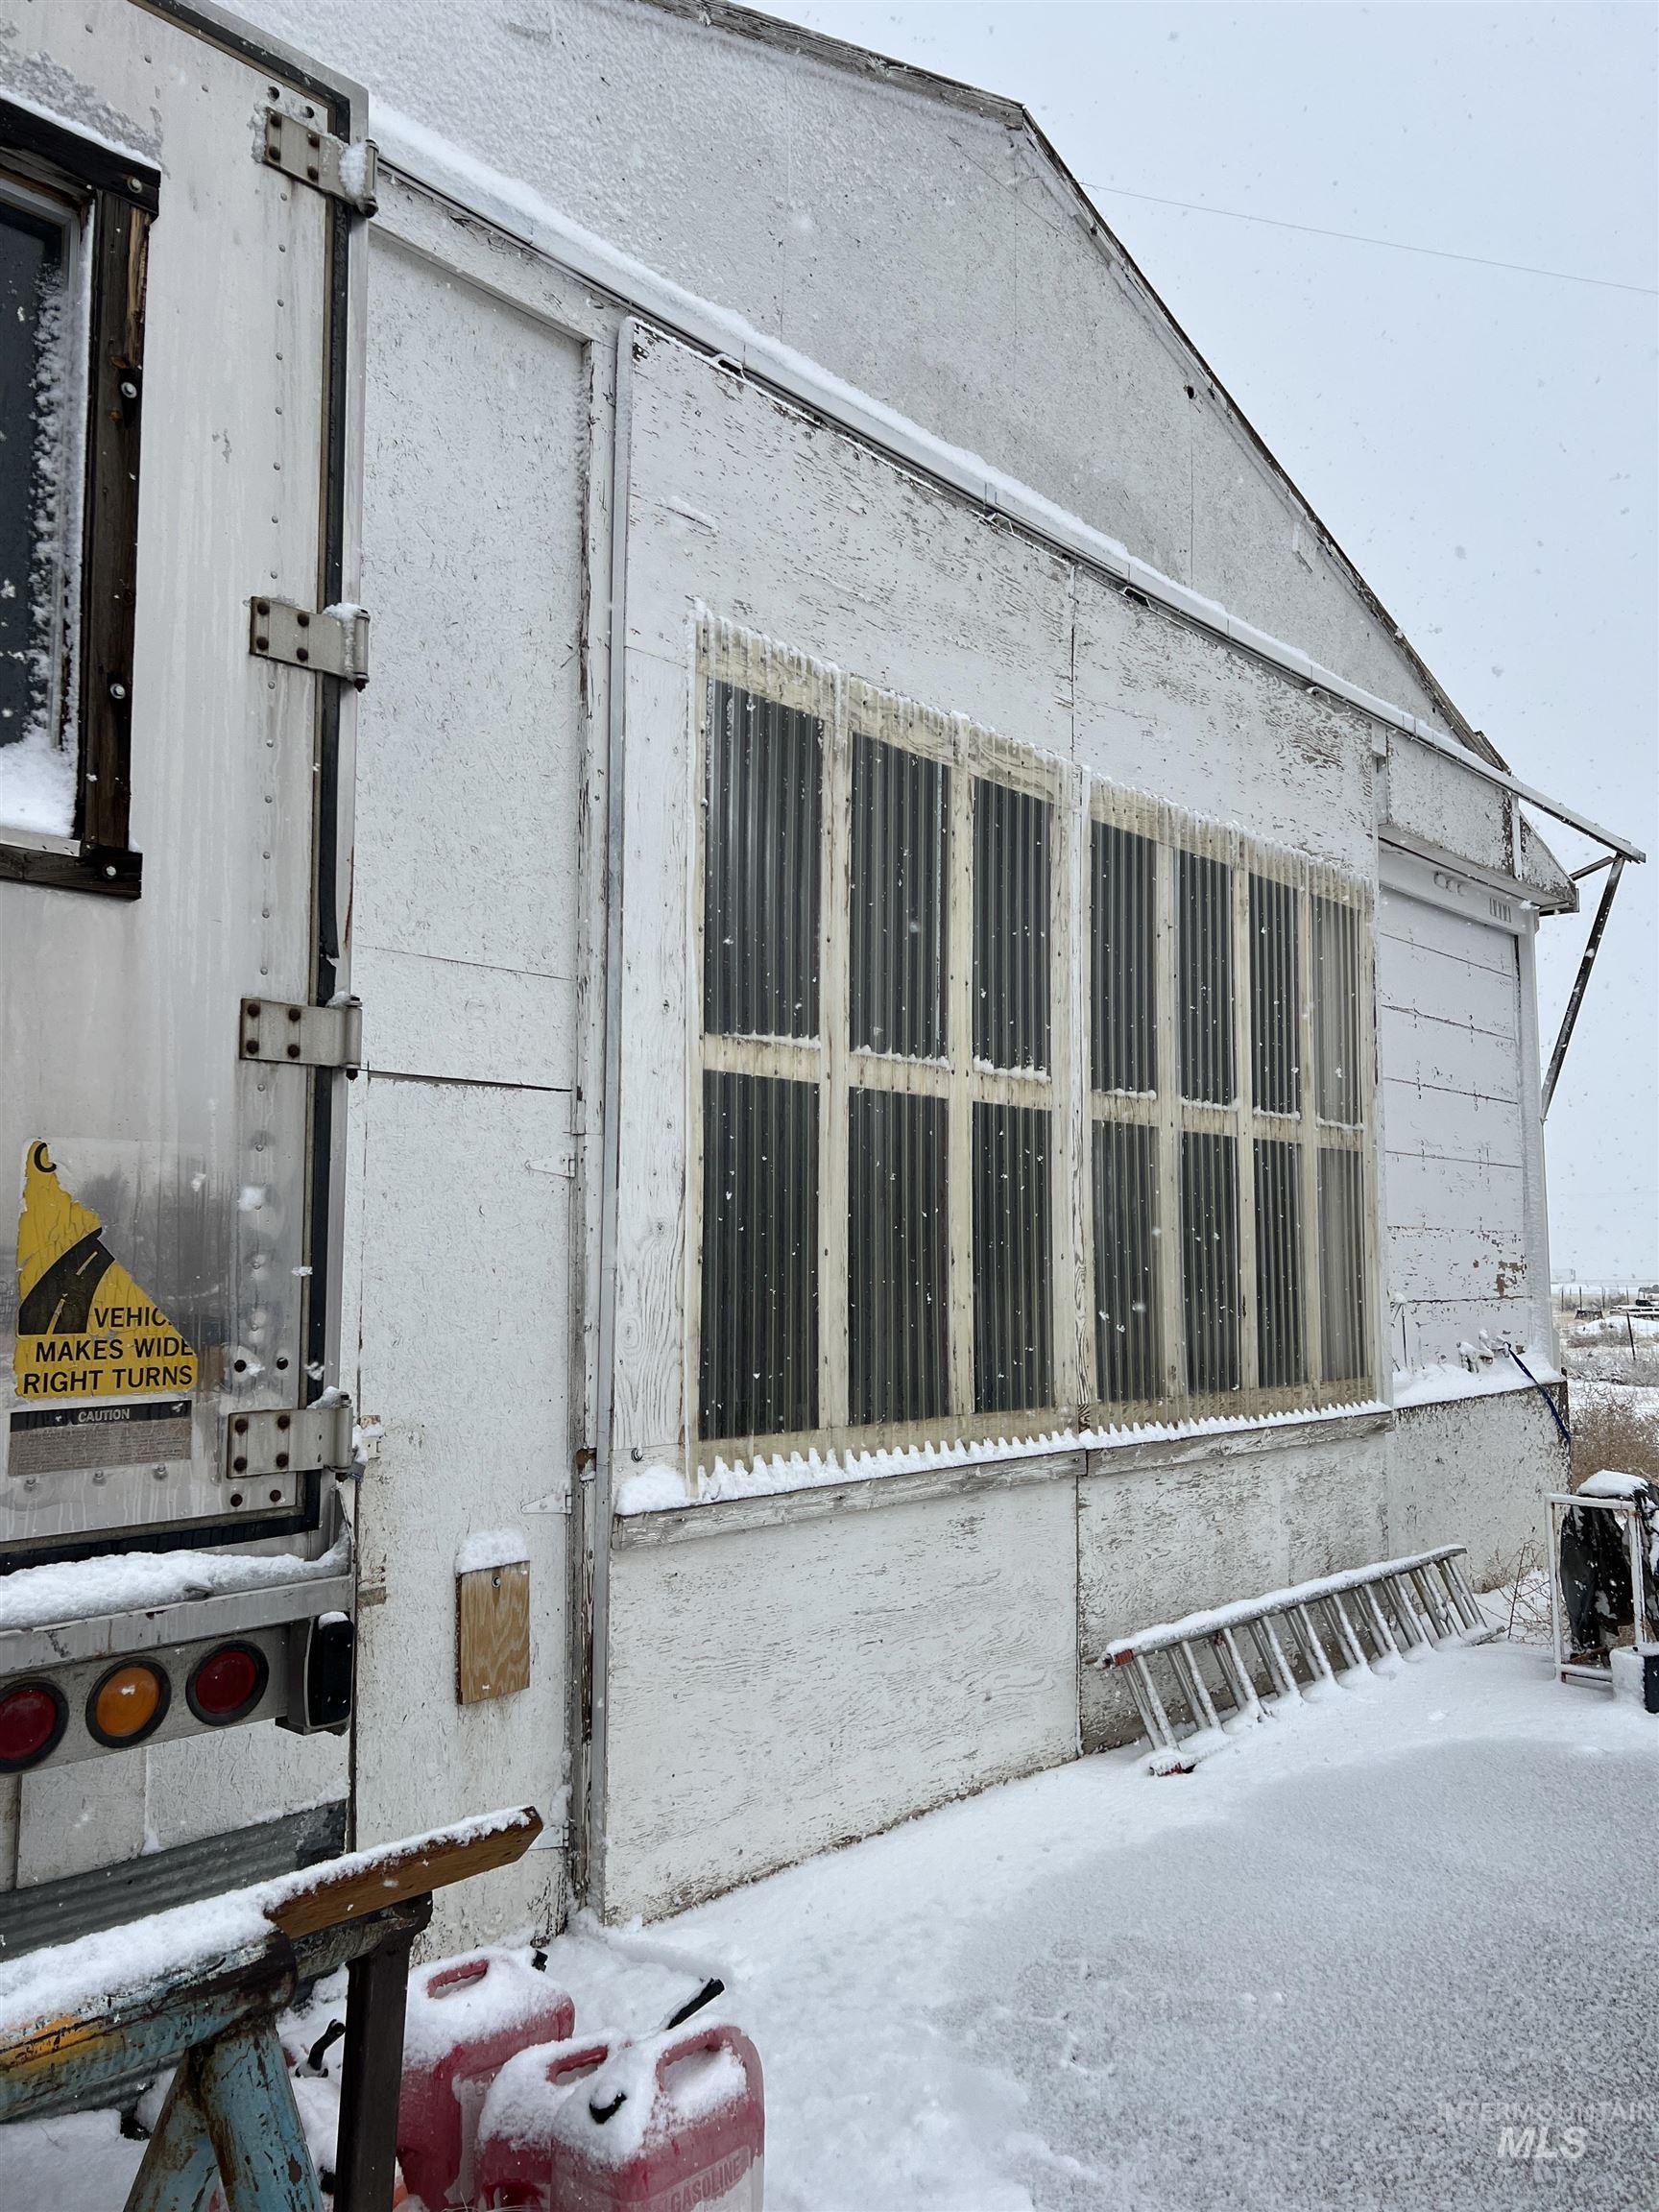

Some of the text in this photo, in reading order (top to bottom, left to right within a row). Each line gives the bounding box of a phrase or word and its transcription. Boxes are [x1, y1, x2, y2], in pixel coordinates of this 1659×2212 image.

[93, 1307, 172, 1329] VEHIC
[35, 1336, 193, 1363] MAKES WIDE
[23, 1364, 193, 1395] RIGHT TURNS
[78, 1407, 131, 1424] CAUTION
[670, 2155, 742, 2212] GASOLINE
